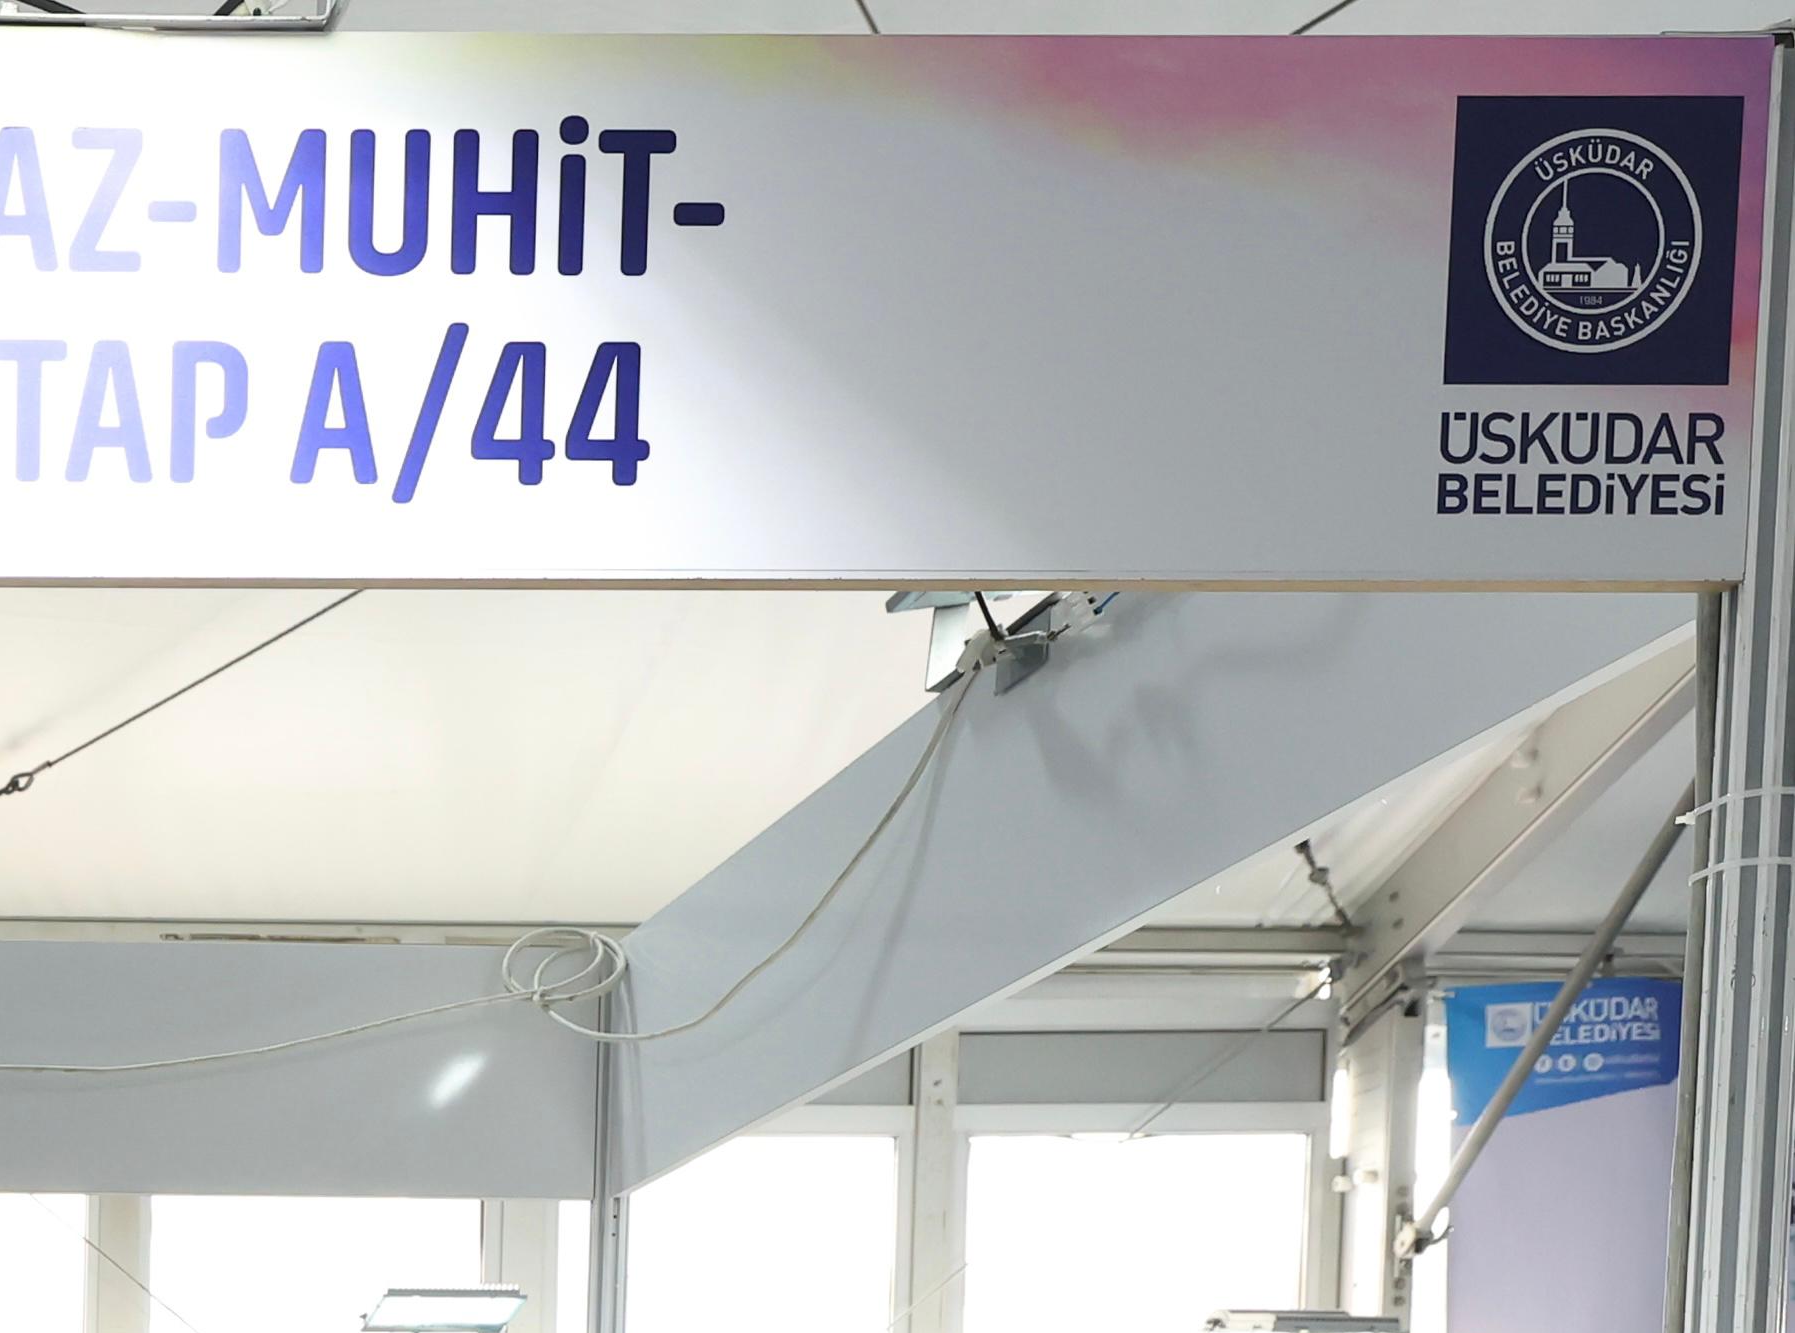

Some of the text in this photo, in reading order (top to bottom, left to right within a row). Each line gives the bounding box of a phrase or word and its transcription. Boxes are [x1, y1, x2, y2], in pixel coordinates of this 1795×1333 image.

[1533, 138, 1655, 182] ÜSKÜDAR
[1495, 240, 1691, 342] BELEDİYE BAŞKANLIĞI
[289, 321, 652, 505] A/44
[1439, 411, 1726, 466] ÜSKÜDAR
